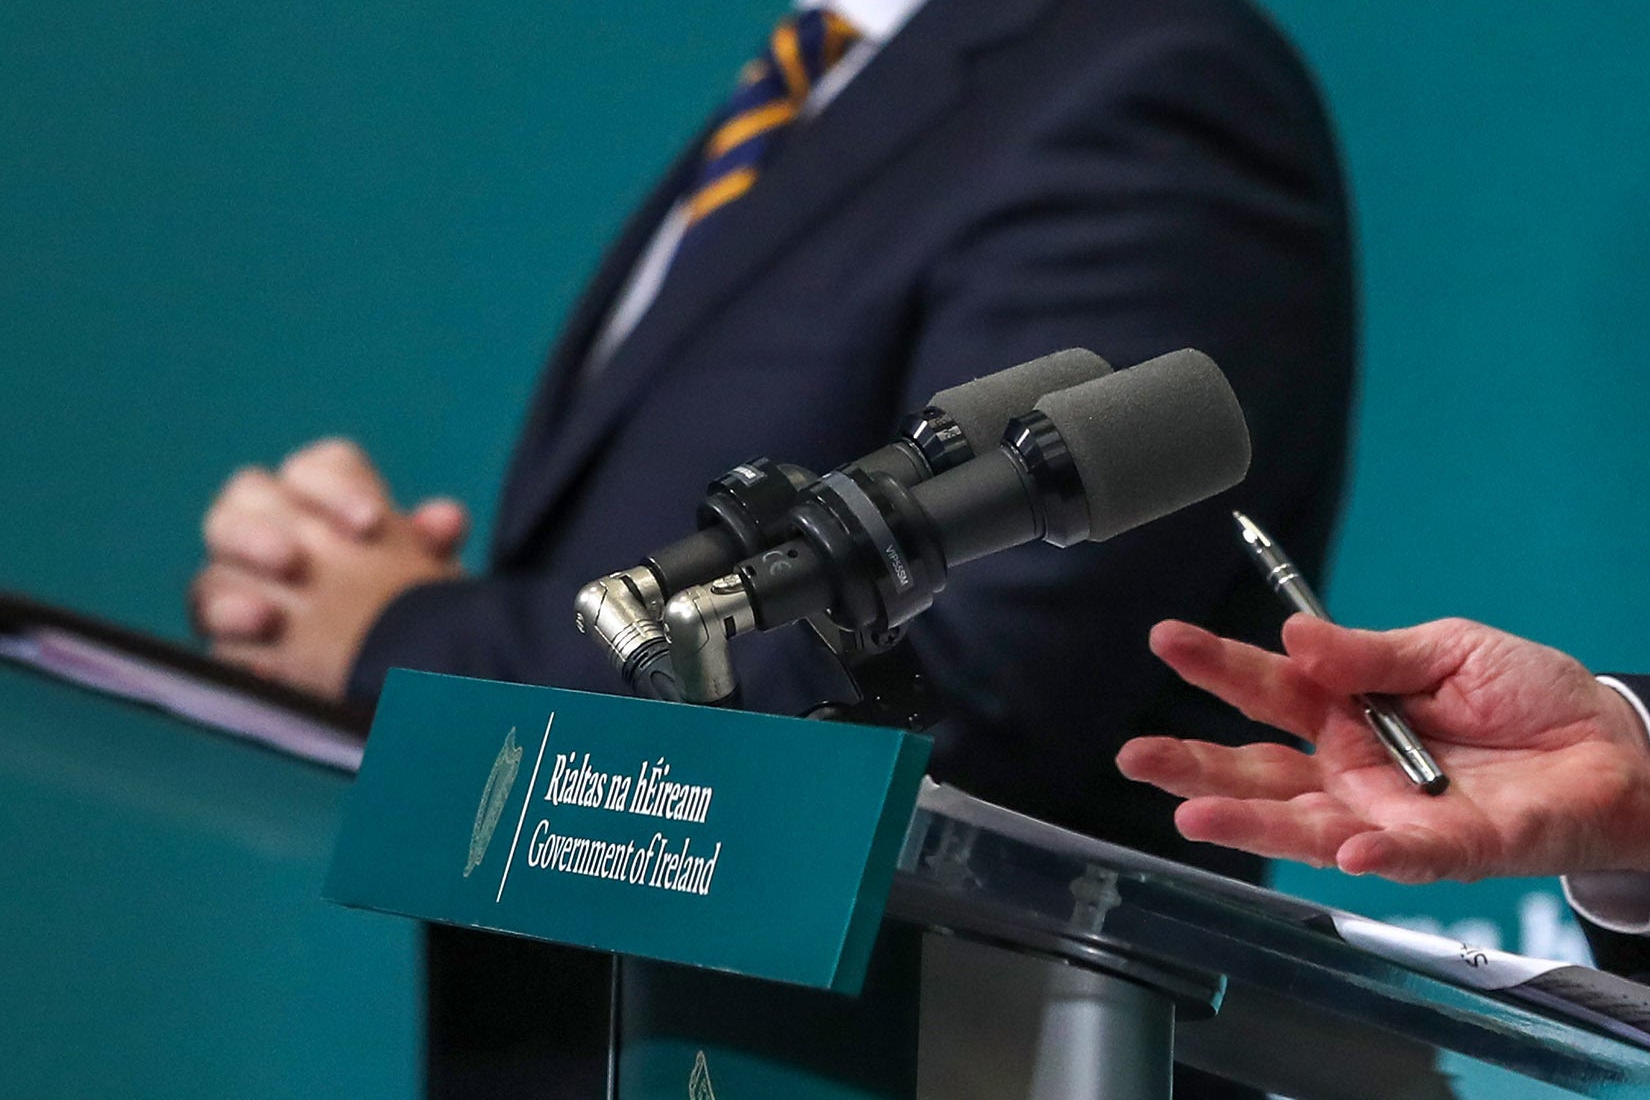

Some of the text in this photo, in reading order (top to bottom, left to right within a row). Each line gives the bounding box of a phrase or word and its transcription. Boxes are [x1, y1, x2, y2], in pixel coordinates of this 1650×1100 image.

[544, 752, 713, 823] Rialtas na hÉireann
[529, 819, 721, 895] Government of Ireland
